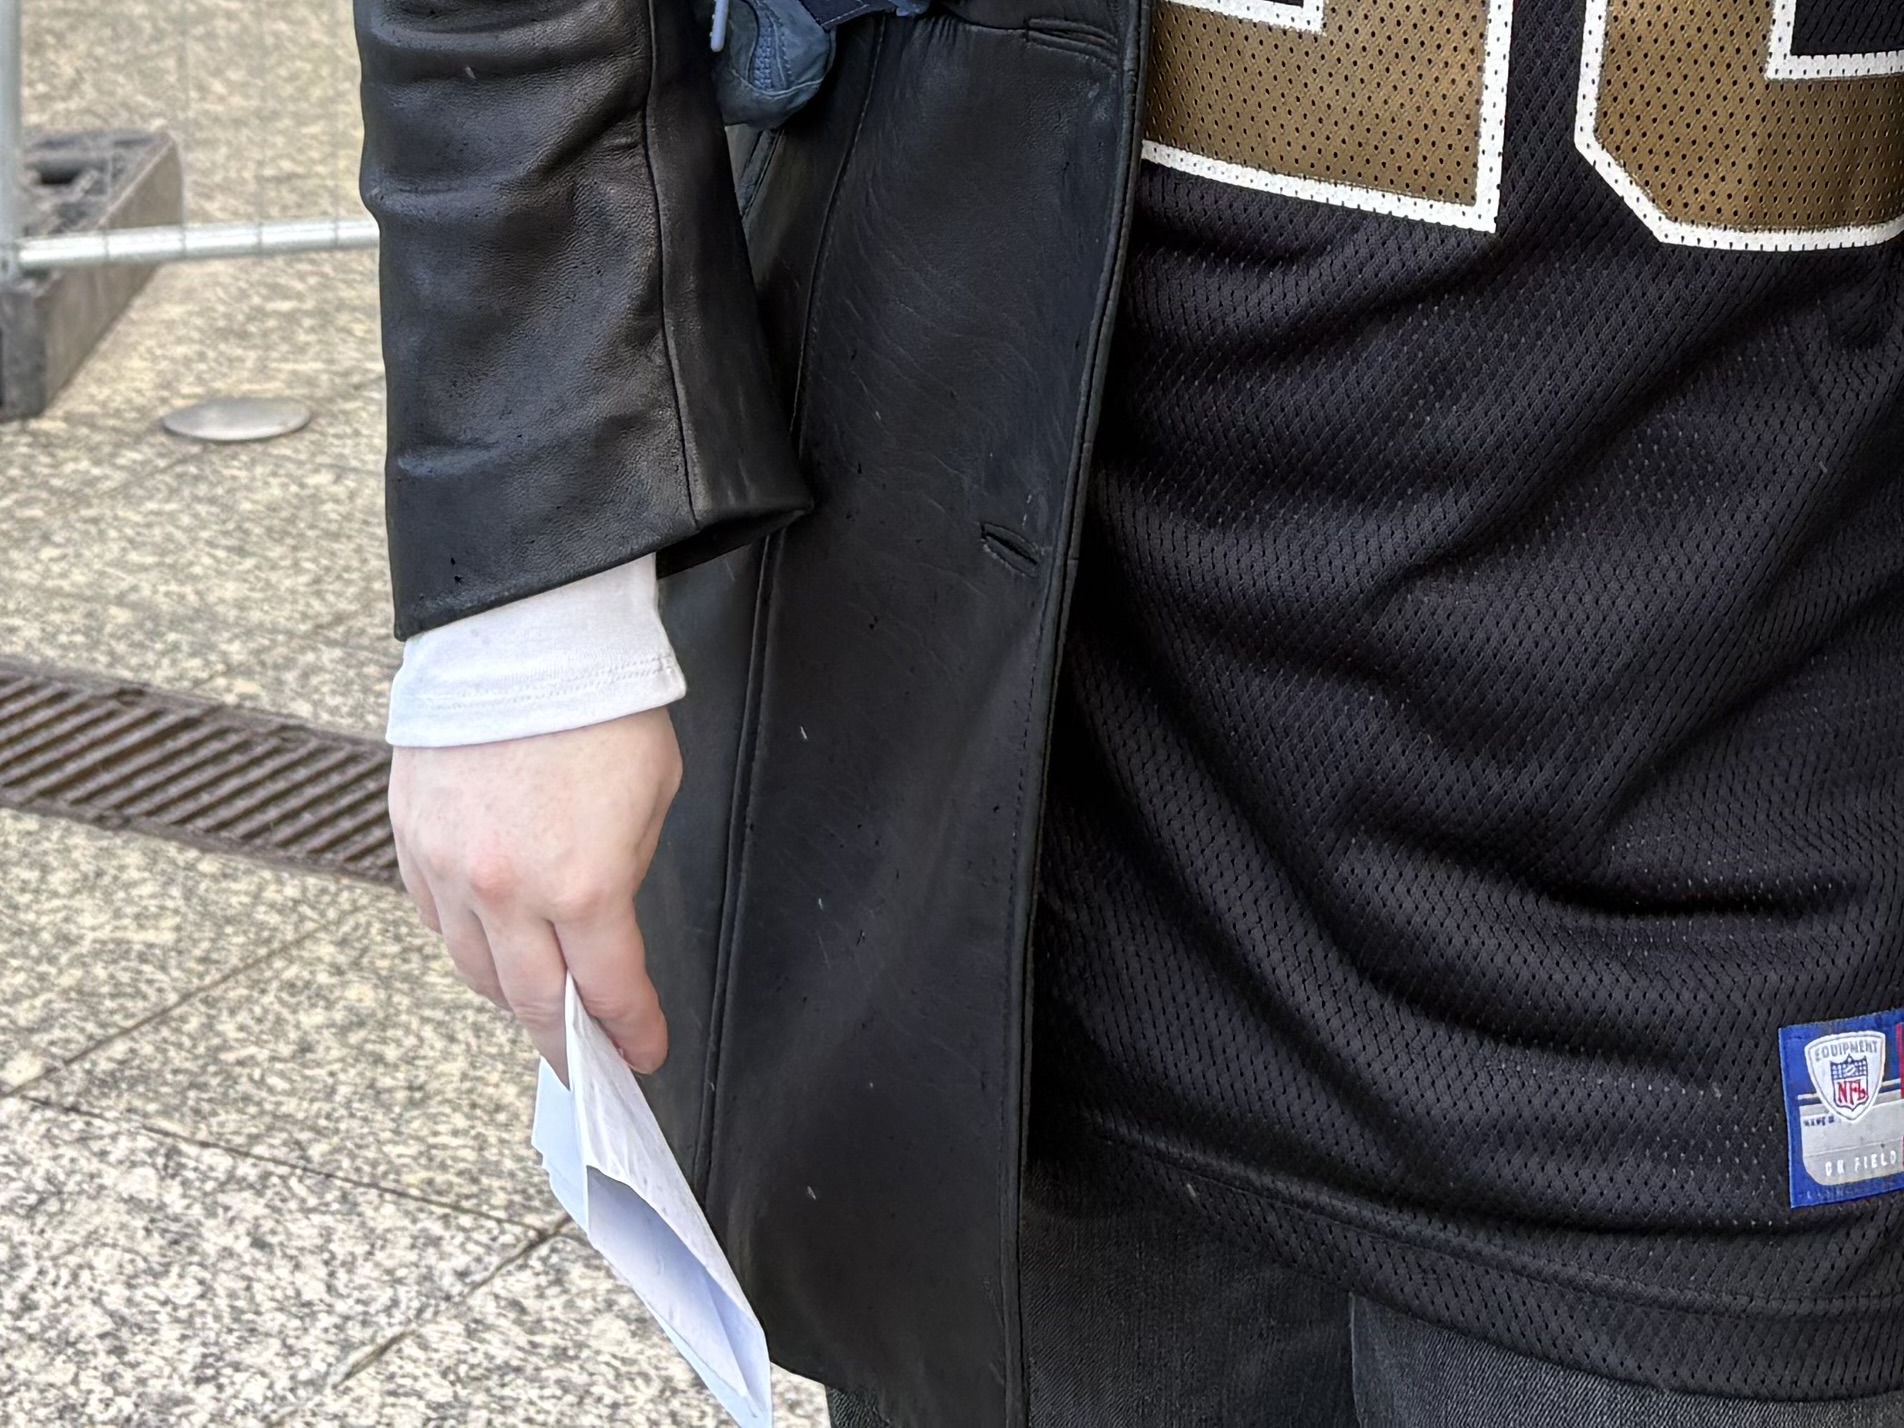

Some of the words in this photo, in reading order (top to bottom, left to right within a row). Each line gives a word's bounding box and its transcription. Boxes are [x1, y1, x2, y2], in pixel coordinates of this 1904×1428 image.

[1814, 1039, 1879, 1061] EQUIPMENT
[1836, 1079, 1869, 1106] NFL
[1854, 1150, 1897, 1172] FIELD
